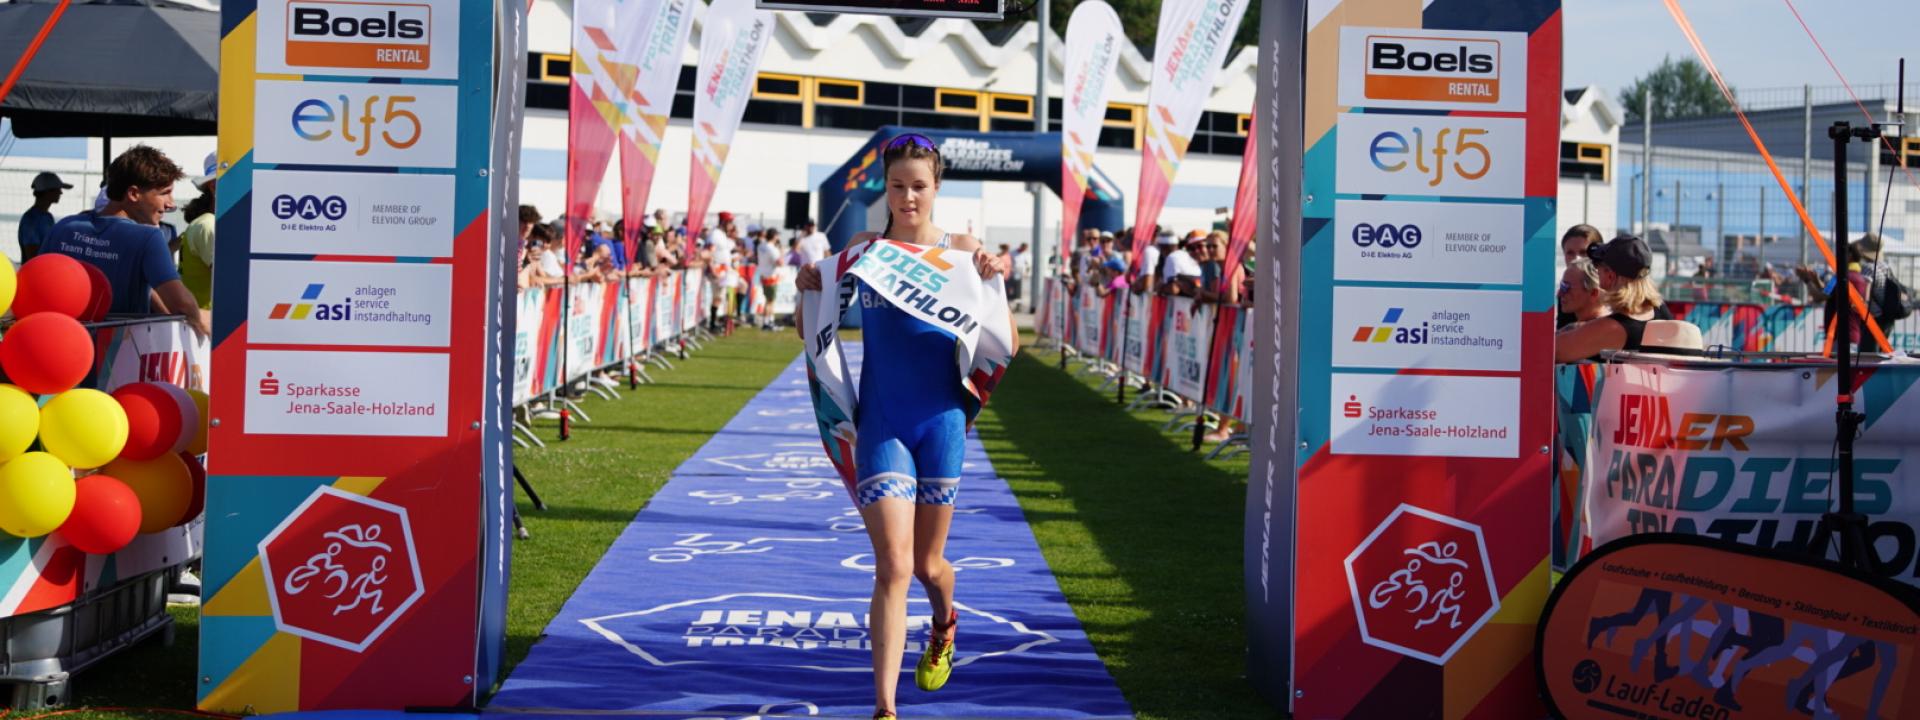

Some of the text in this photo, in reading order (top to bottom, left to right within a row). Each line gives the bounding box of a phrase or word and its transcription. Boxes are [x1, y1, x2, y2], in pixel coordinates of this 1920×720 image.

[294, 7, 424, 39] Boels
[376, 48, 423, 63] RENTAL
[729, 18, 764, 97] TRIATHLON
[1372, 42, 1493, 73] Boels
[1448, 82, 1492, 97] RENTAL
[292, 94, 422, 157] elf5
[1271, 40, 1281, 244] TRIATHLON
[950, 158, 1024, 171] TRIATHLON
[1369, 126, 1491, 187] elf5
[275, 196, 344, 218] EAG
[372, 204, 422, 214] MEMBER OF
[298, 223, 324, 231] Elektro
[325, 224, 337, 232] AG
[371, 216, 437, 226] ELEVION GROUP
[73, 231, 110, 247] Triathlon
[1355, 225, 1419, 246] EAG
[1445, 232, 1492, 242] MEMBER OF
[61, 242, 119, 260] Team Bremen
[1445, 243, 1507, 254] ELEVION GROUP
[355, 284, 397, 299] anlagen
[315, 297, 351, 321] asi
[354, 299, 390, 309] service
[354, 310, 431, 325] instandhaltung
[1431, 310, 1471, 324] anlagen
[1395, 321, 1428, 345] asi
[1431, 323, 1465, 334] service
[1431, 335, 1504, 350] instandhaltung
[1269, 257, 1282, 453] PARADIES
[286, 383, 361, 398] Sparkasse
[286, 401, 436, 416] Jena-Saale-Holzland
[1368, 406, 1437, 421] Sparkasse
[1613, 394, 1755, 451] JENAER
[1368, 423, 1508, 439] Jena-Saale-Holzland
[1606, 449, 1902, 515] PARADIES
[1261, 460, 1275, 603] JENAER
[1602, 562, 1651, 578] Laufschuhe
[1661, 571, 1729, 595] Laufbekleidung
[1738, 587, 1782, 608] Beratung
[1861, 616, 1919, 635] Textildruck
[1605, 674, 1730, 720] Lauf-Laden
